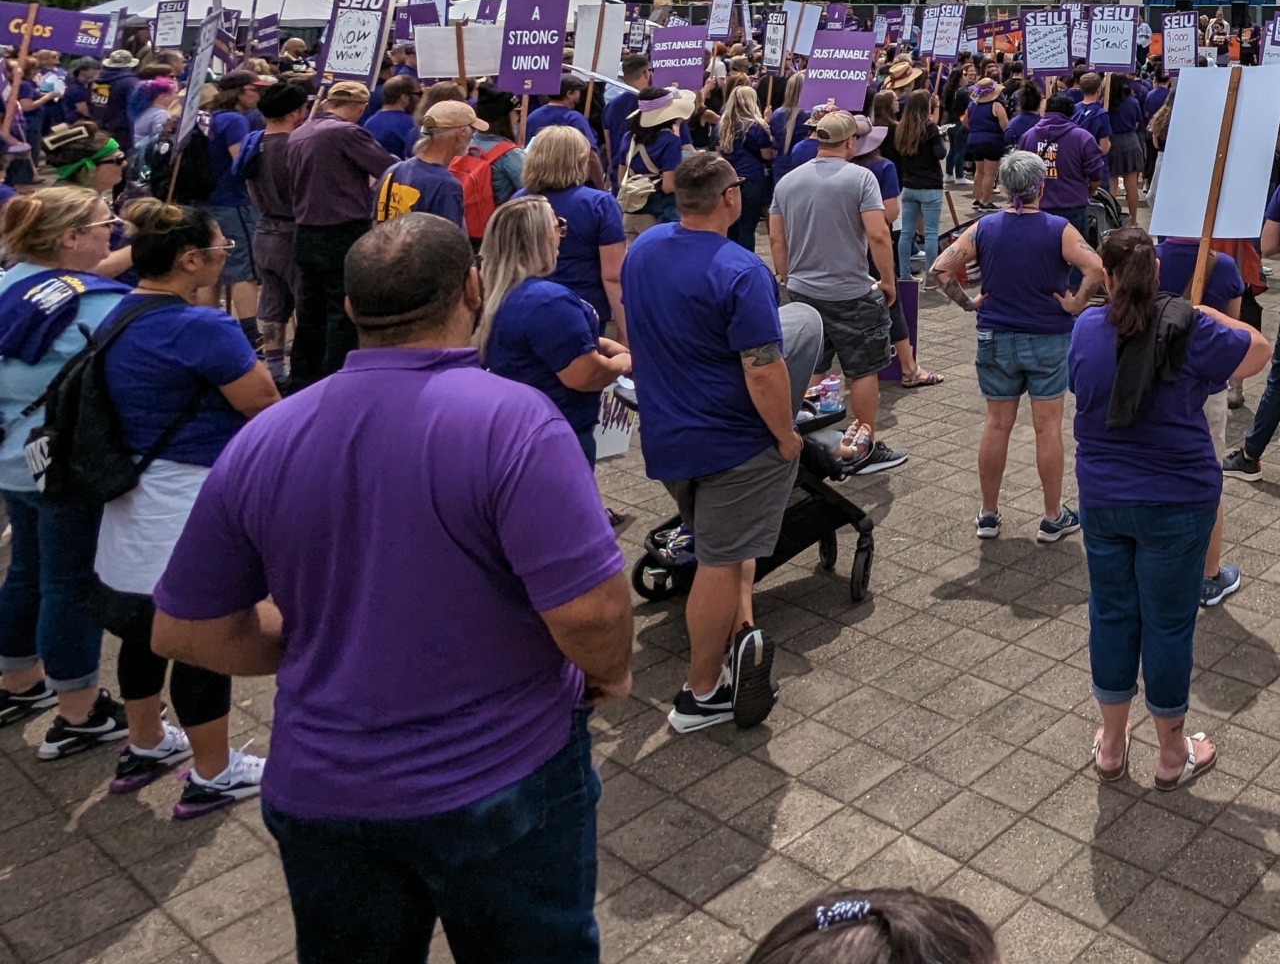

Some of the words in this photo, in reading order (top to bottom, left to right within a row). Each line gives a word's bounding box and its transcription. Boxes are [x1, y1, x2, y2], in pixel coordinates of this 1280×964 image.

[160, 2, 186, 12] SEIU
[940, 5, 963, 17] SEIU
[531, 6, 541, 21] A
[767, 13, 786, 24] SEIU
[1025, 11, 1066, 26] SEIU
[1093, 7, 1135, 20] SEIU
[827, 22, 843, 30] STRONG
[1074, 21, 1088, 30] SE
[1164, 14, 1195, 29] SEIU
[1095, 23, 1125, 35] UNION
[75, 36, 100, 45] SEIU
[508, 29, 559, 45] STRONG
[654, 40, 702, 51] SUSTAINABLE
[813, 48, 871, 60] SUSTAINABLE
[512, 55, 550, 70] UNION
[652, 57, 703, 68] WORKLOADS
[808, 69, 867, 81] WORKLOADS
